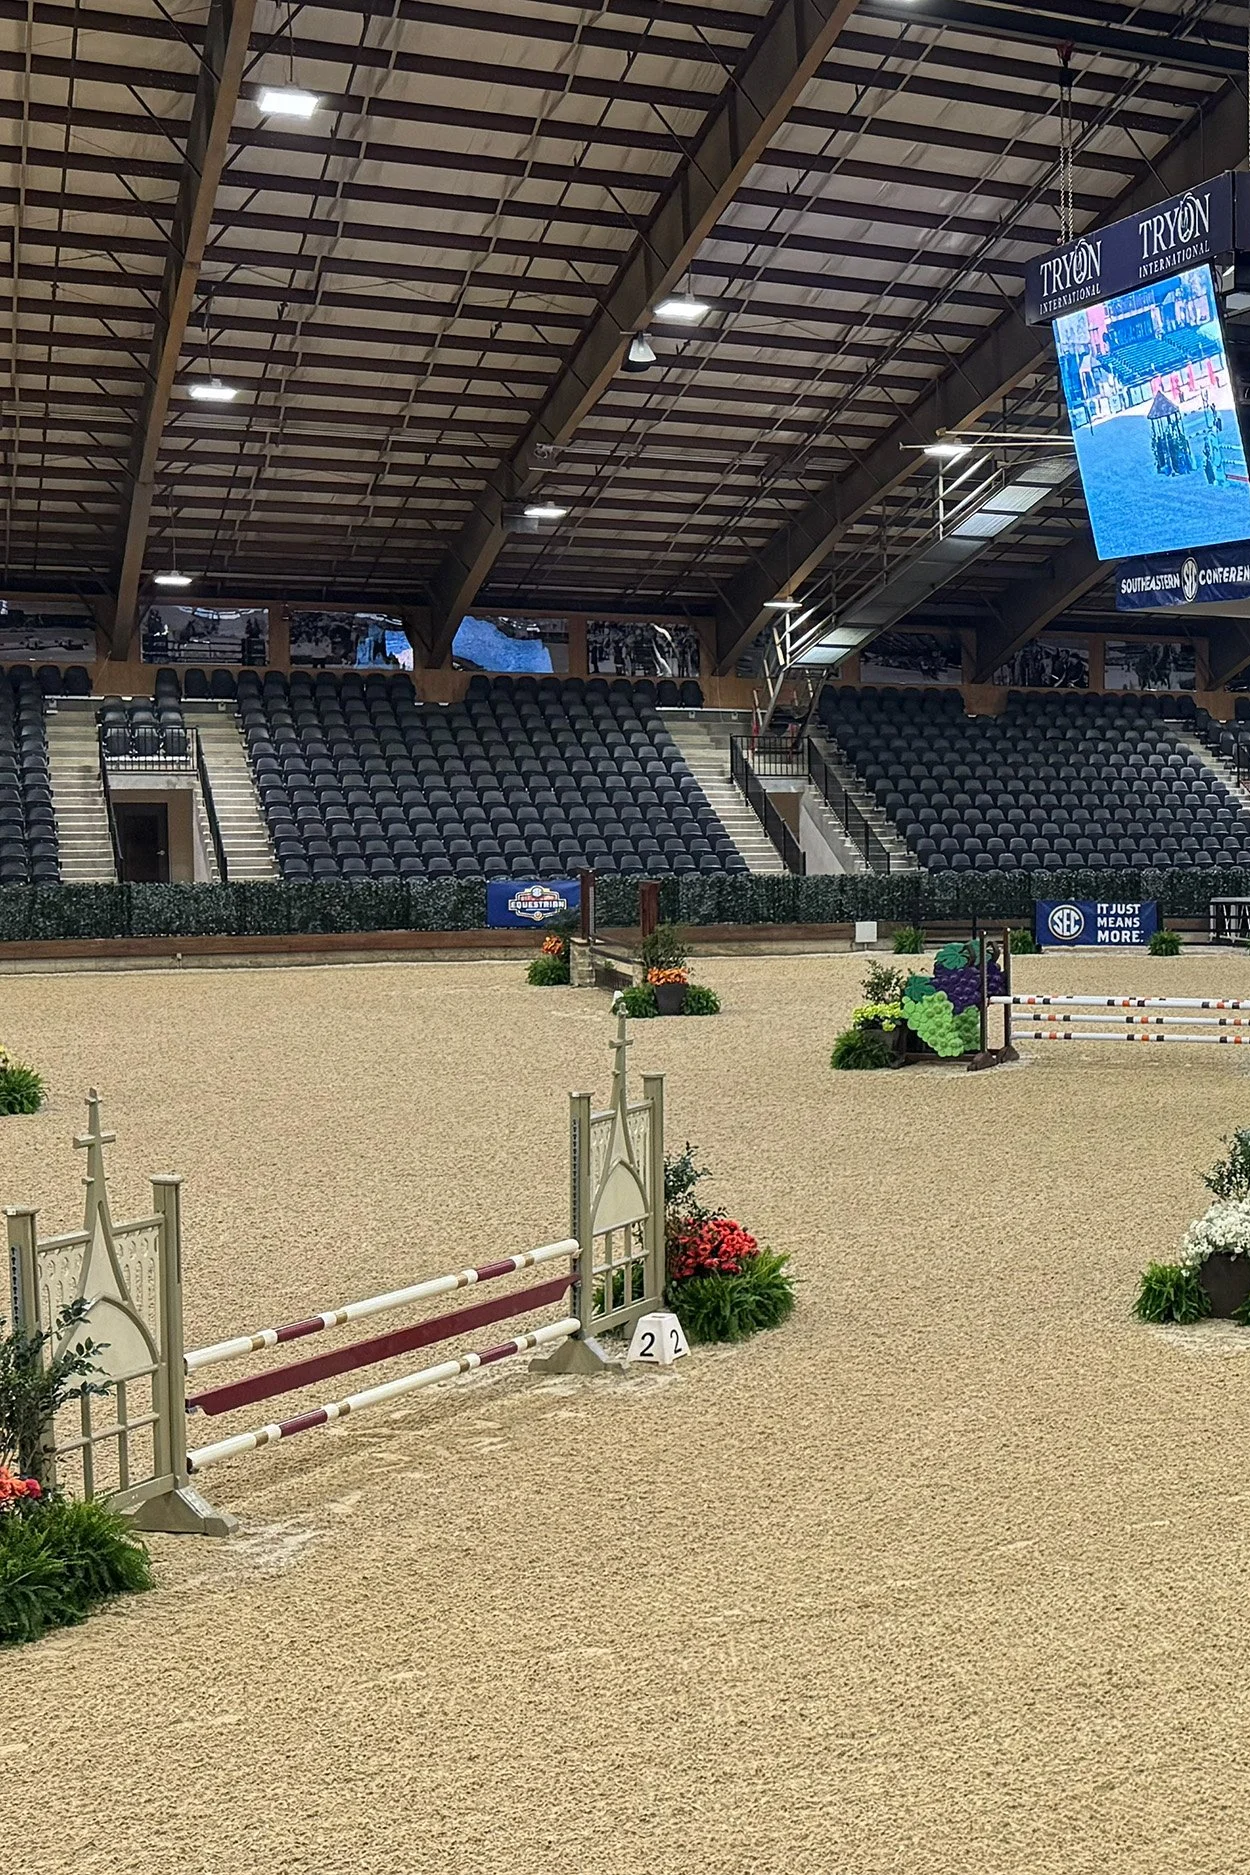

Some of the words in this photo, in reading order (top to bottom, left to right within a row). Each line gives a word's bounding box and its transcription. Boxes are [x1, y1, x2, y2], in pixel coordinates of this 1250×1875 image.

[1138, 192, 1211, 260] TRYON
[1039, 238, 1102, 297] TRYON
[1138, 240, 1210, 279] INTERNATIONAL
[1039, 282, 1101, 315] INTERNATIONAL
[1121, 573, 1180, 594] SOUTHEASTERN
[510, 900, 564, 909] EQUESTRIAN
[1097, 903, 1109, 914] IT
[1109, 903, 1141, 914] JUST
[1053, 908, 1080, 936] SEC
[1097, 917, 1140, 928] MEANS
[640, 1332, 655, 1357] 2
[670, 1329, 682, 1354] 2
